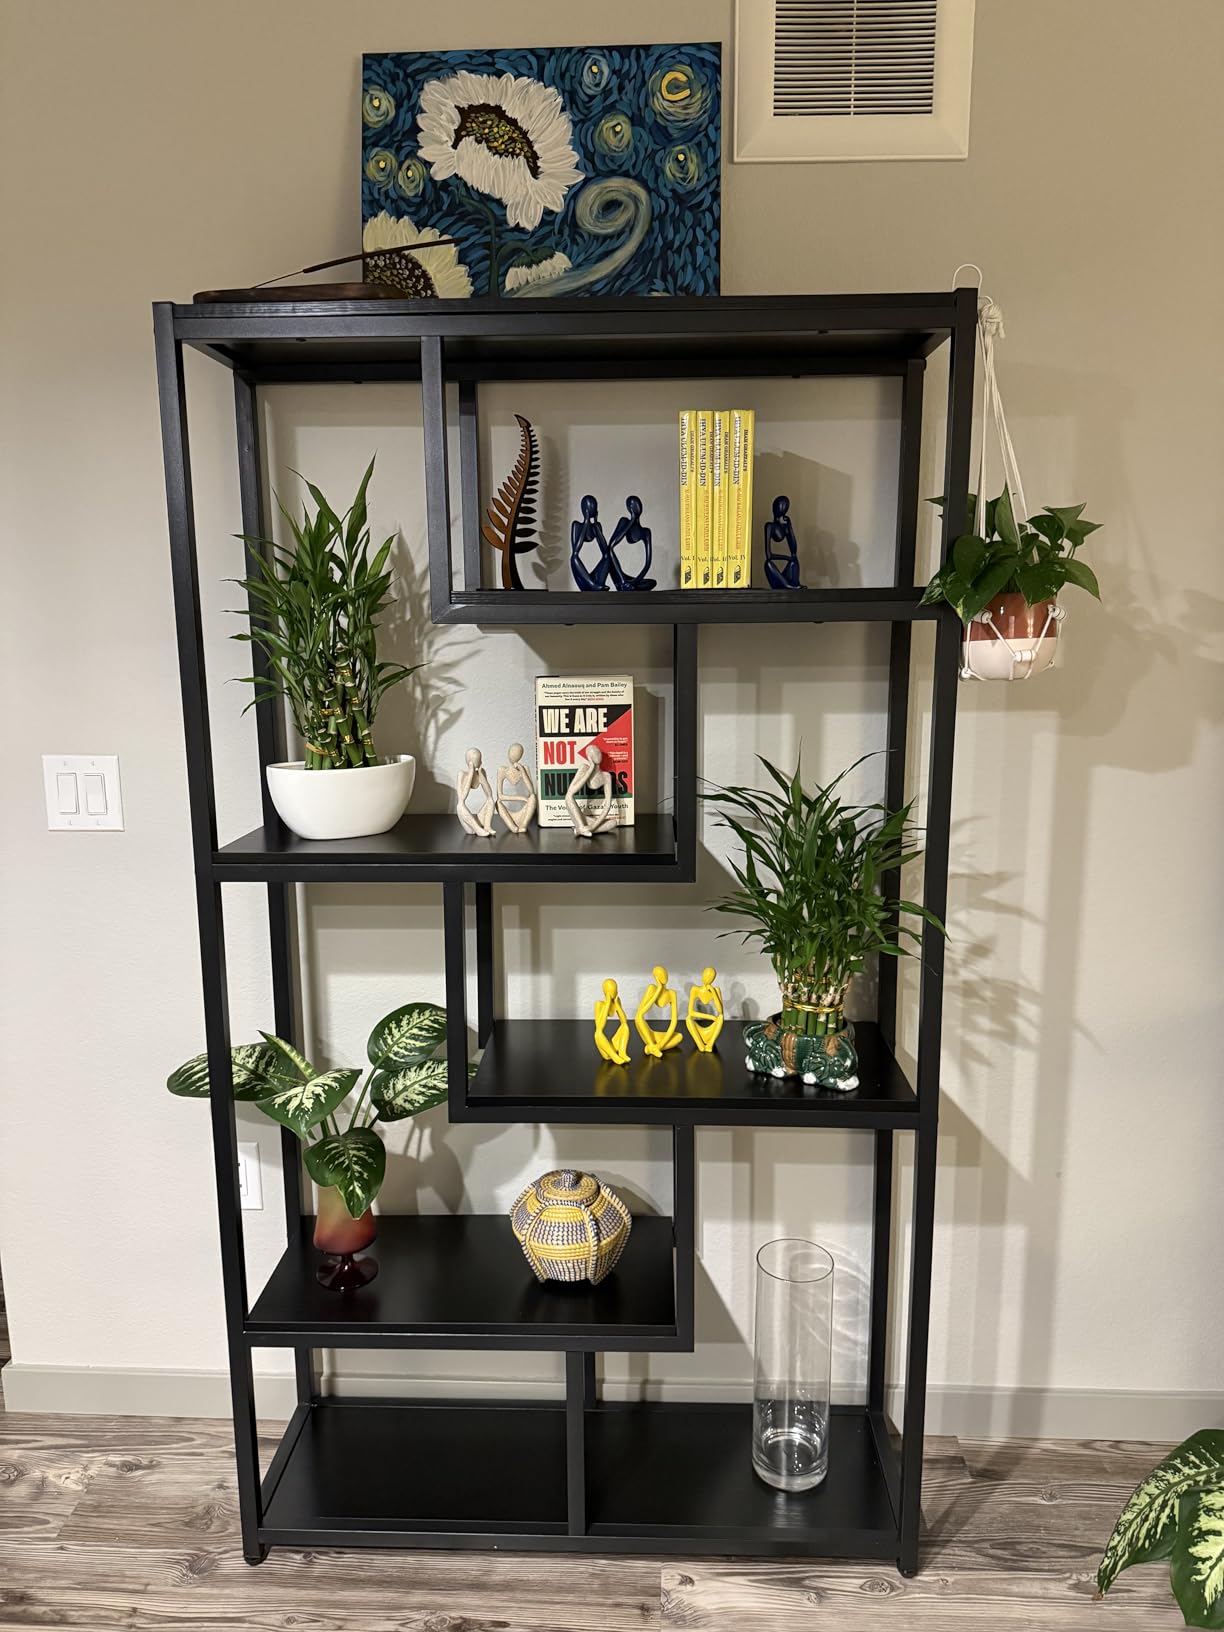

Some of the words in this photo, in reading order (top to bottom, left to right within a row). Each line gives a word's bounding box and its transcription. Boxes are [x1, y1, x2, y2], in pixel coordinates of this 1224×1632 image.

[542, 708, 570, 734] WE
[573, 708, 608, 733] ARE
[544, 741, 576, 765] NOT
